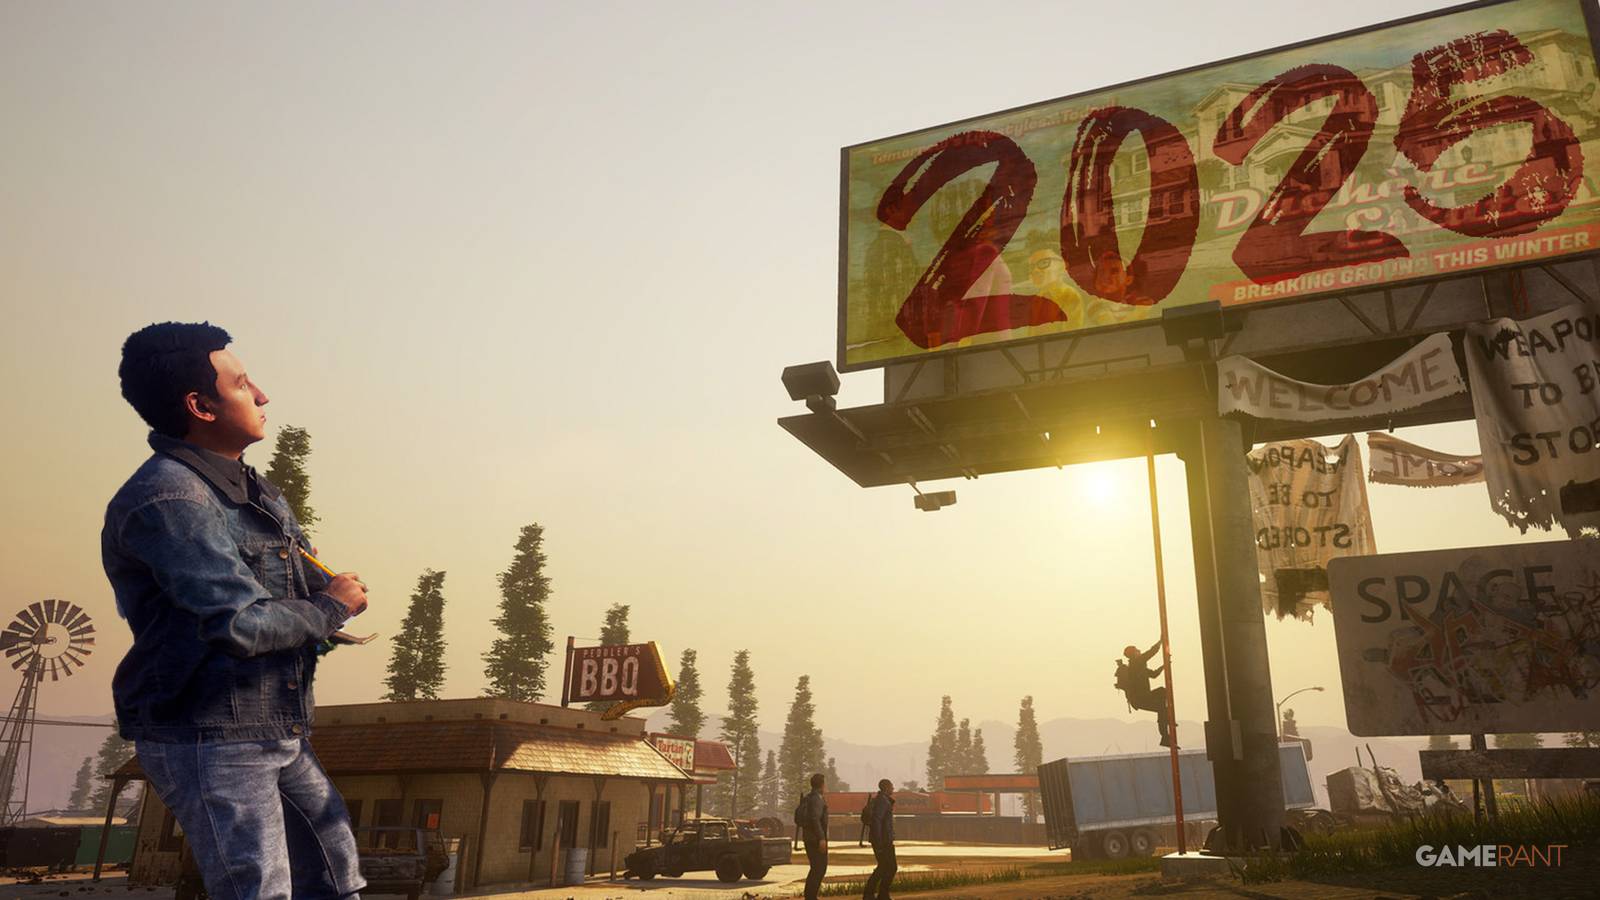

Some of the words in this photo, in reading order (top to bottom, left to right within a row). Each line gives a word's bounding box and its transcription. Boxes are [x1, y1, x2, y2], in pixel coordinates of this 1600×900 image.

[1234, 271, 1335, 300] BREAKING
[1435, 247, 1488, 269] THIS
[1494, 231, 1590, 259] WINTER
[1479, 315, 1600, 361] WEAPO
[1226, 346, 1449, 412] WELCOME
[1511, 382, 1562, 408] TO
[1357, 565, 1561, 624] SPACE
[580, 656, 639, 697] BBQ
